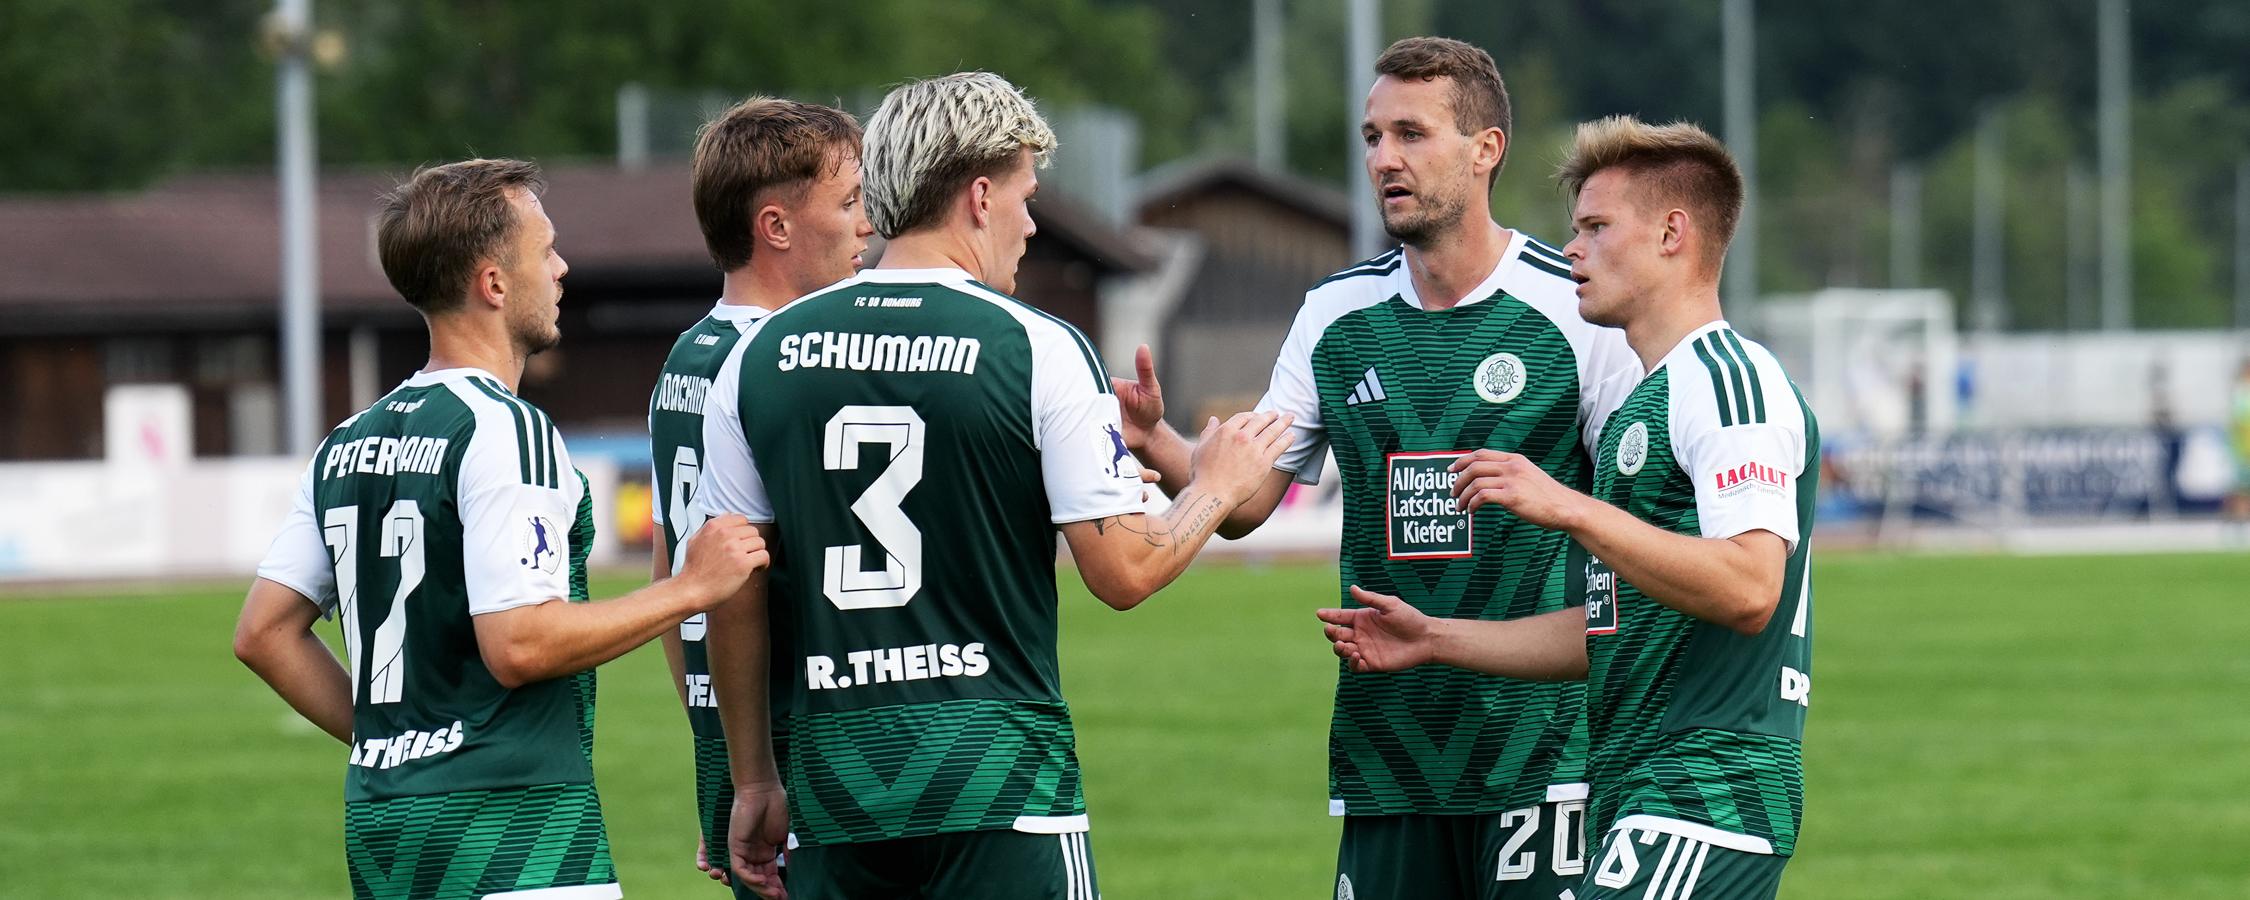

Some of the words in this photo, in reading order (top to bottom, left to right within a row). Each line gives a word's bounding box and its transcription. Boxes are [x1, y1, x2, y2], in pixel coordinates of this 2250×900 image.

[854, 296, 867, 307] FC
[880, 297, 923, 308] HOMBURG
[778, 331, 981, 376] SCHUMANN
[322, 435, 449, 480] PETERANN
[1715, 461, 1787, 489] LACALUT
[1392, 467, 1461, 496] Allgäue
[822, 405, 926, 611] 3
[805, 642, 990, 690] R.THEISS
[349, 720, 464, 770] THEISS
[1496, 801, 1586, 881] 20
